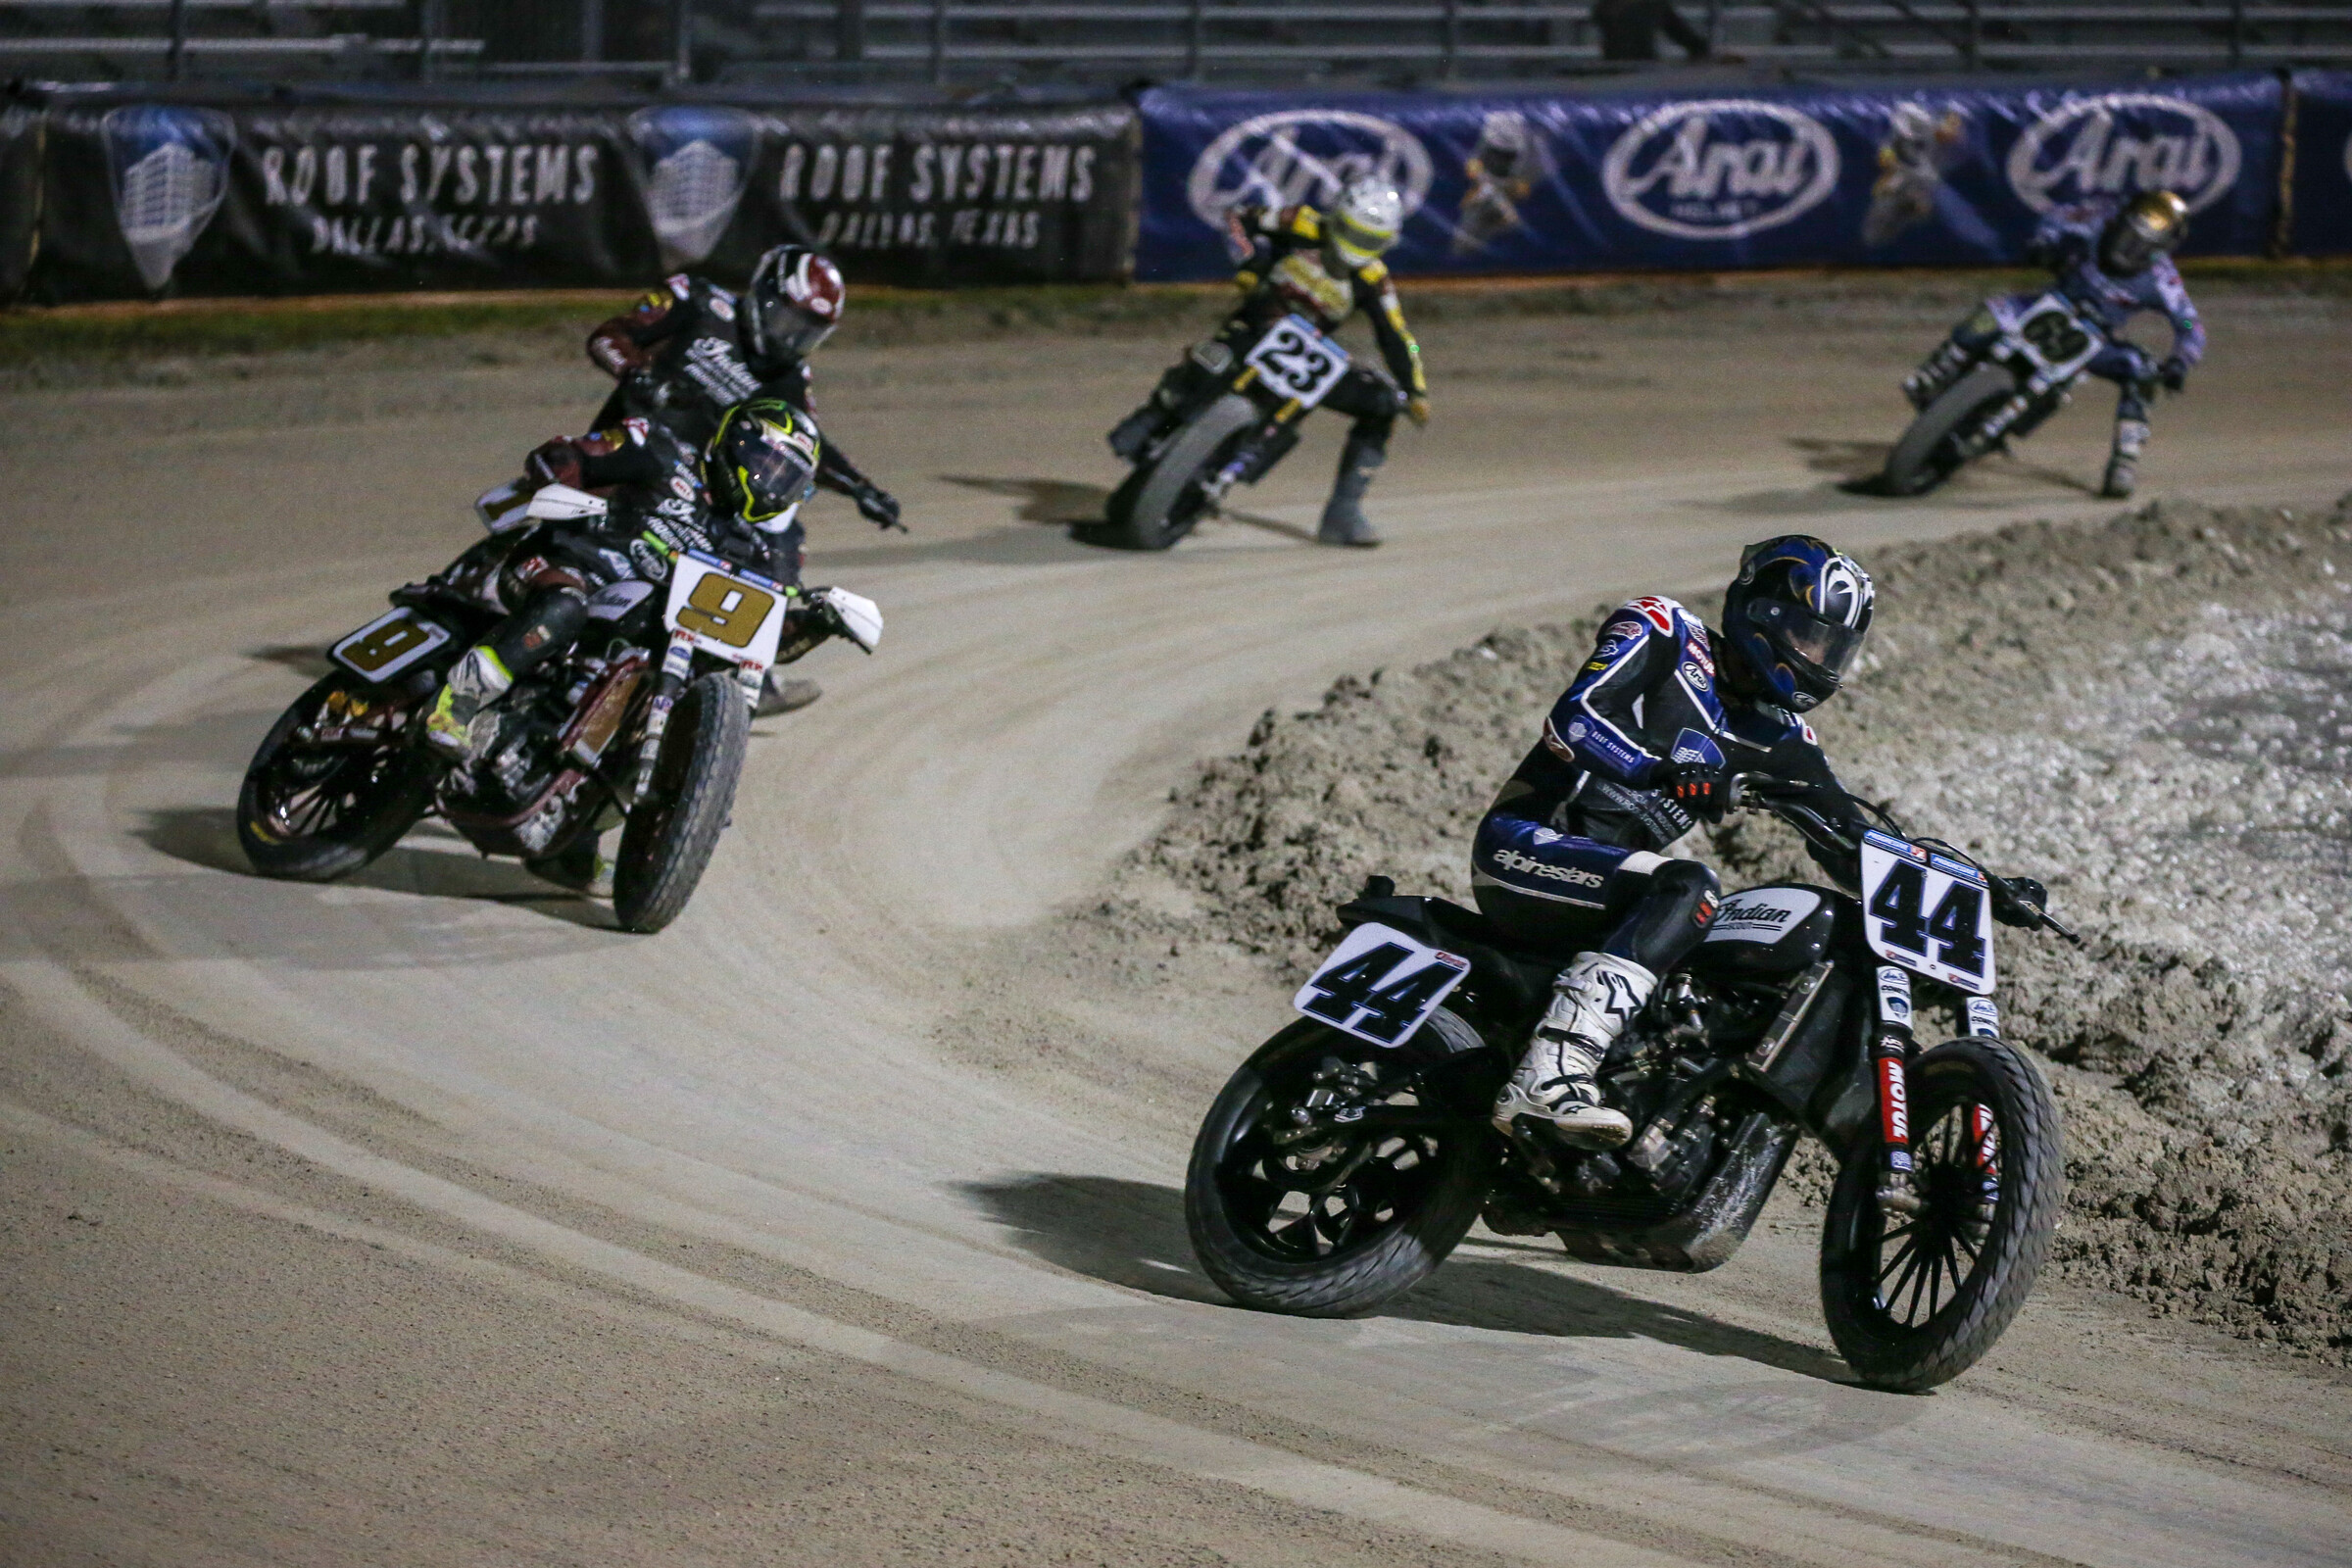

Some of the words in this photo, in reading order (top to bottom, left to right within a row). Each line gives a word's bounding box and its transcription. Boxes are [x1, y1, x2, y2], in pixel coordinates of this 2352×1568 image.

[263, 144, 378, 207] ROOF
[398, 144, 600, 207] SYSTEMS
[779, 143, 894, 203] ROOF
[909, 143, 1097, 203] SYSTEMS
[1633, 116, 1810, 198] Arai
[2029, 109, 2210, 194] Arai
[1256, 329, 1337, 389] 23
[675, 571, 776, 649] 9
[341, 619, 430, 672] 9
[1688, 642, 1715, 674] MOTUL
[1607, 742, 1636, 763] SYSTEMS
[1493, 849, 1604, 889] alpinestars
[1717, 899, 1791, 923] Indian
[1868, 858, 1987, 978] 44
[1302, 941, 1464, 1045] 44
[1887, 1060, 1909, 1138] MOTUL
